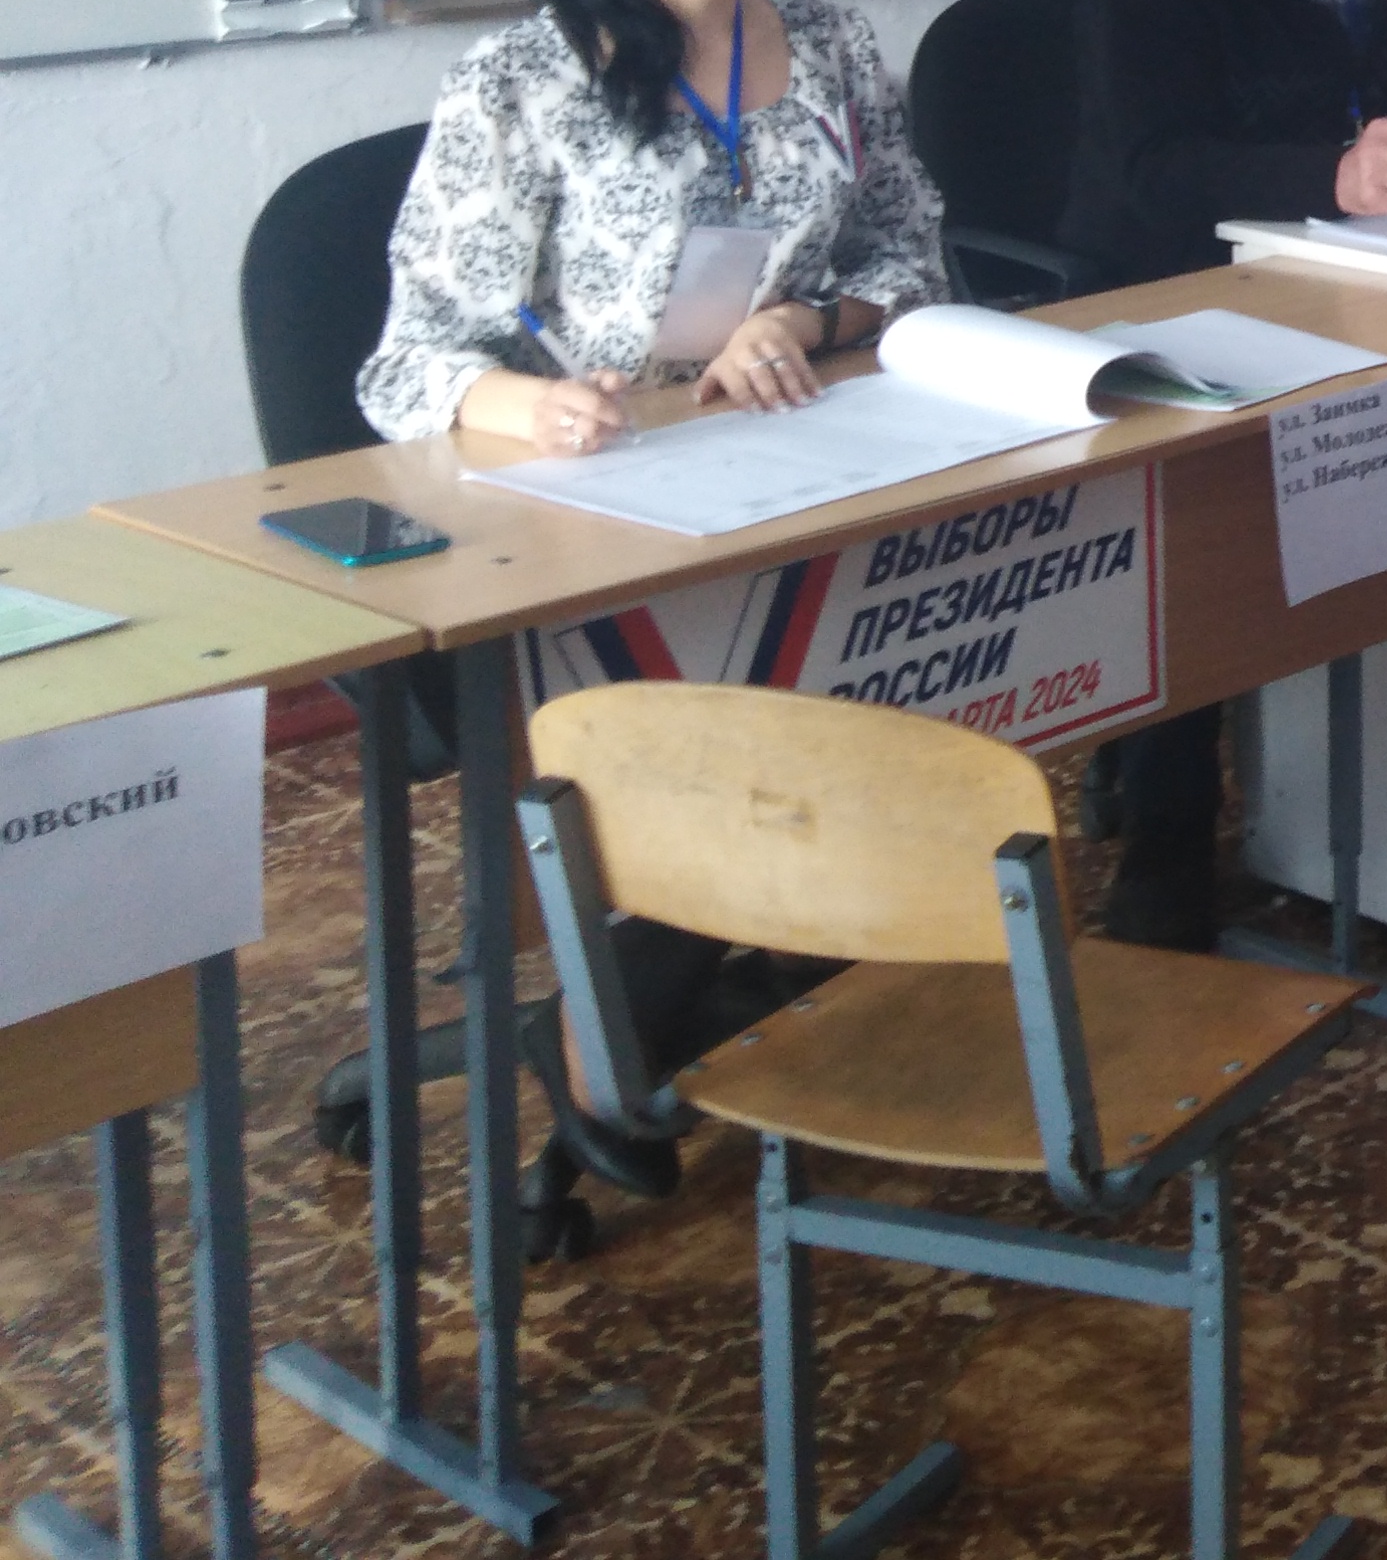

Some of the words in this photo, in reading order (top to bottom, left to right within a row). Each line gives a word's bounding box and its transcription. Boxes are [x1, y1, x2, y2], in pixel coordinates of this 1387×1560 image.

[865, 484, 1078, 589] ВЫБОРЫ
[840, 529, 1137, 664] ПРЕЗИДЕНТА
[947, 687, 1018, 734] РТА
[1022, 659, 1103, 723] 2024
[1, 765, 181, 846] овский
